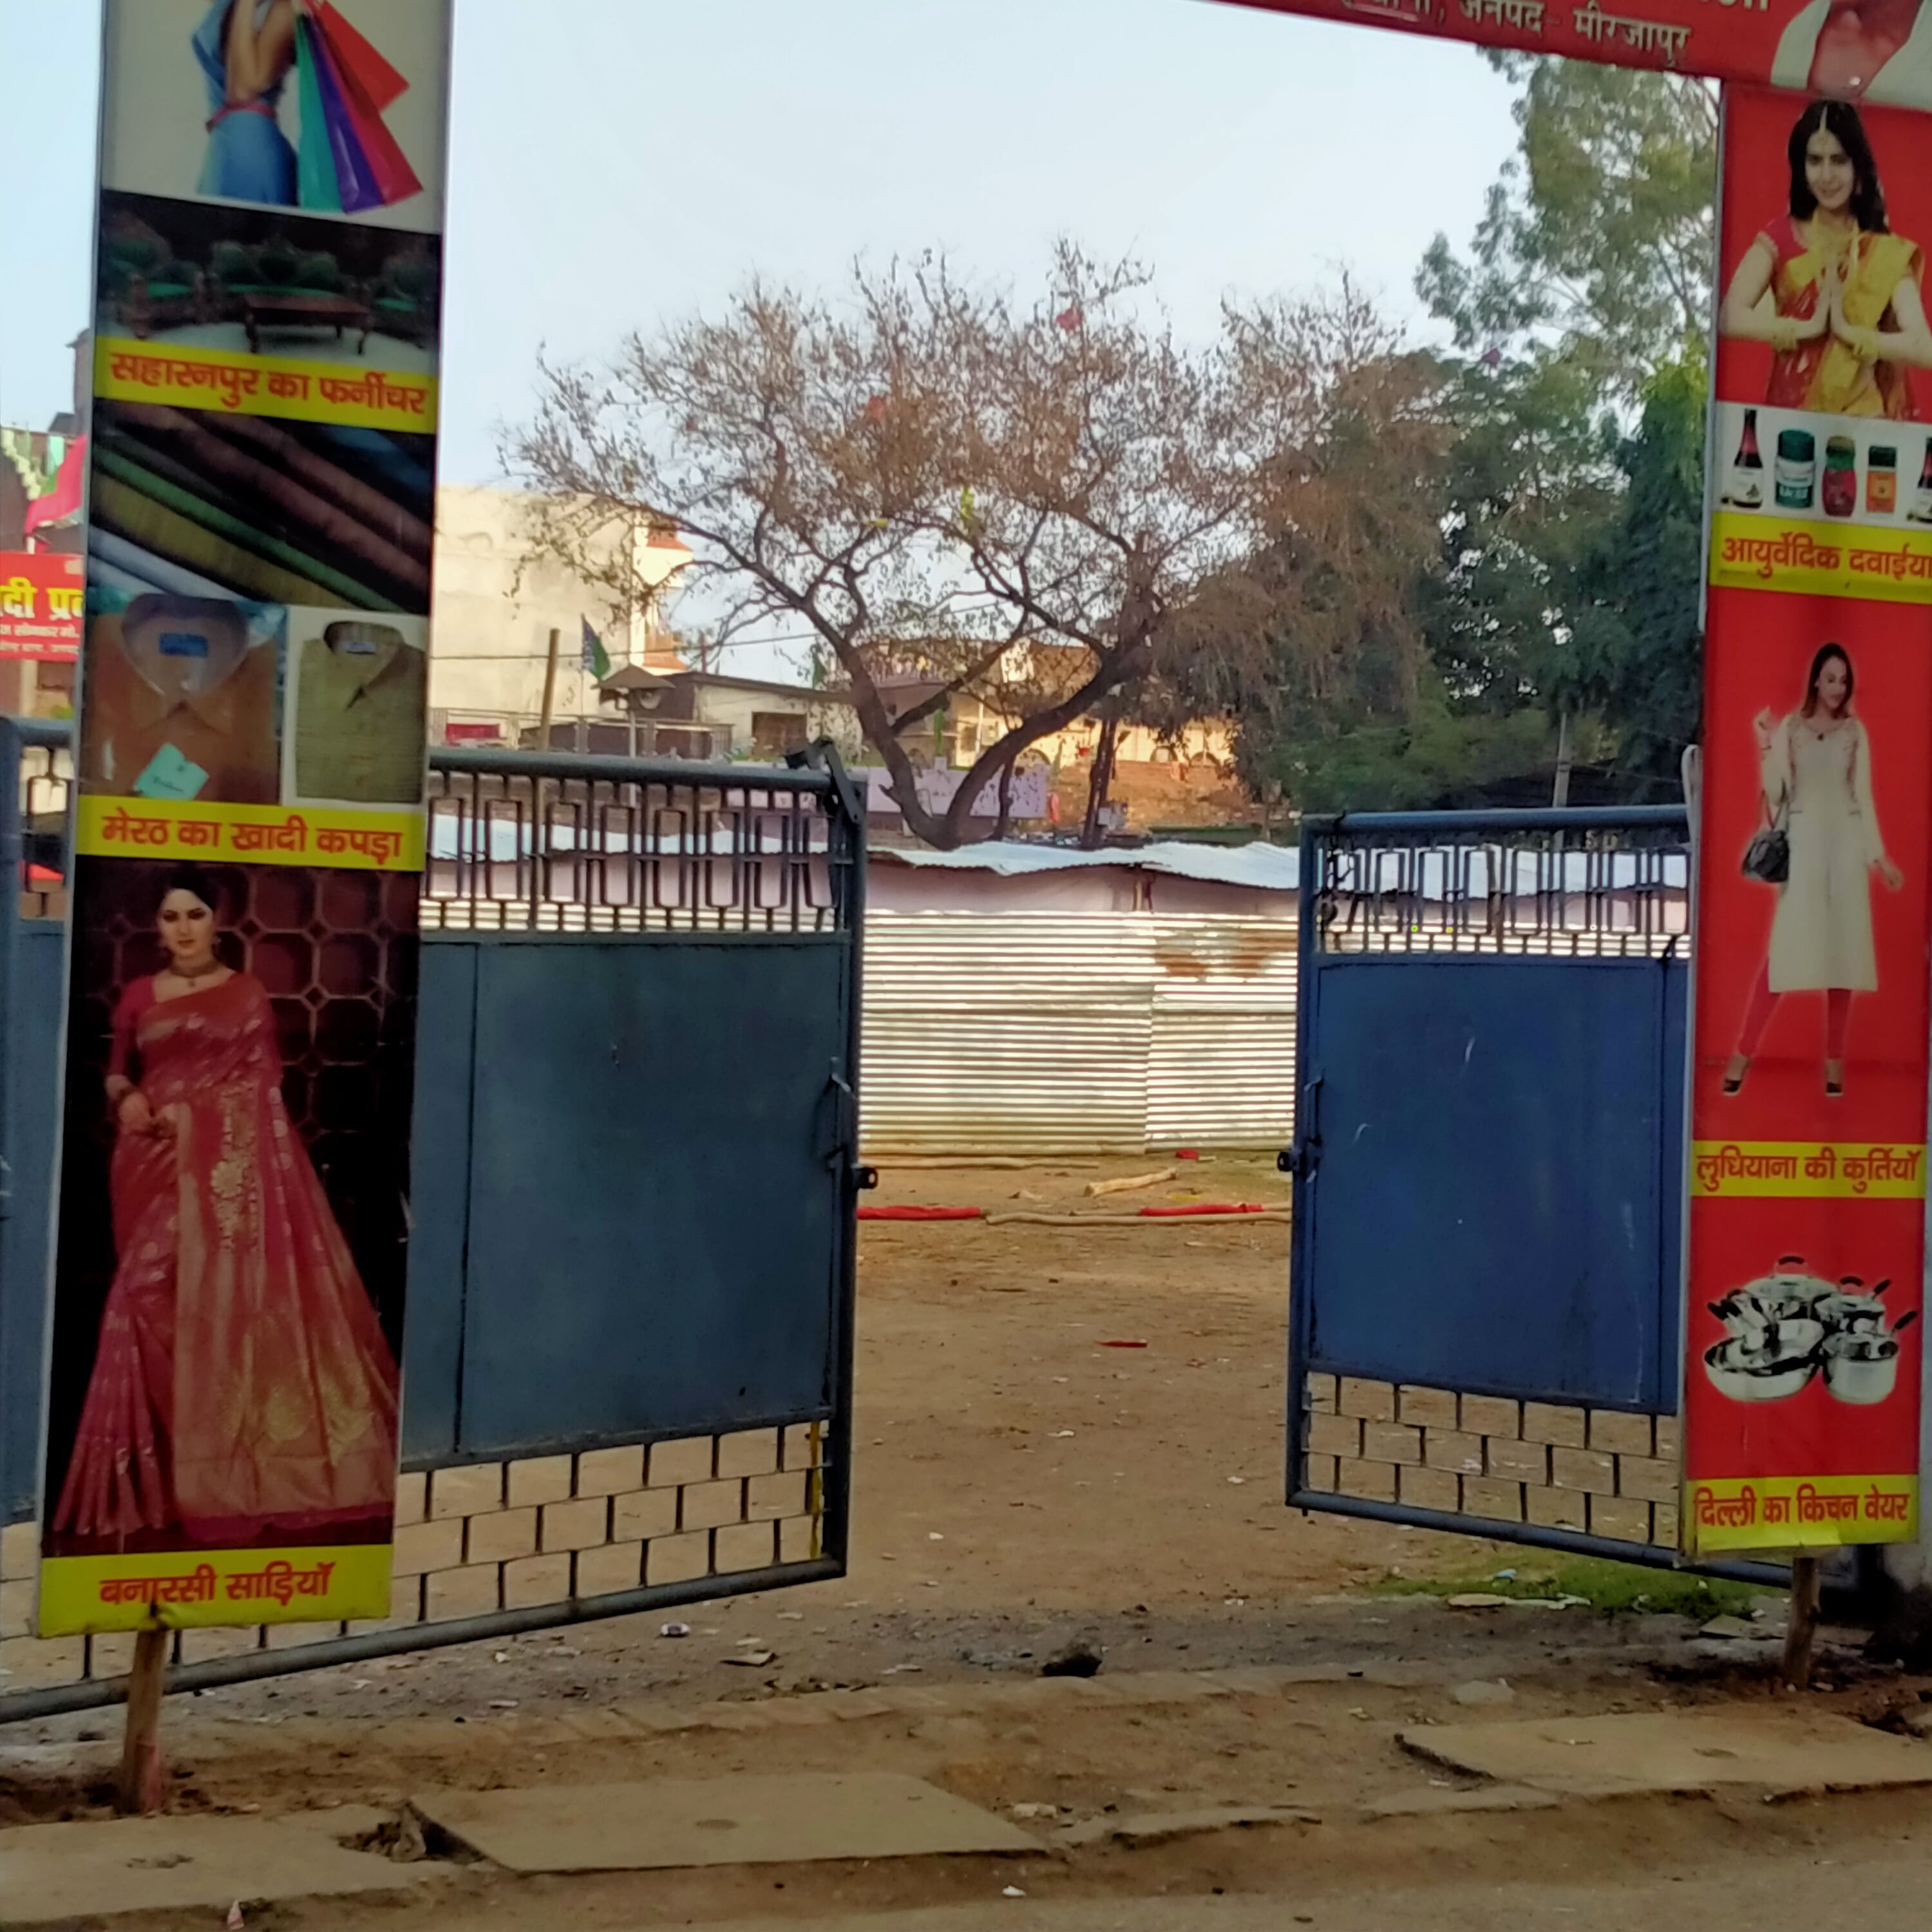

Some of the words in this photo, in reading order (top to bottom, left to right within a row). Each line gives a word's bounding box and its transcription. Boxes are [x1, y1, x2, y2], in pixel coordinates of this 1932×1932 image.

[268, 372, 309, 400] का
[319, 372, 429, 414] फर्नीचर
[101, 806, 171, 845] मेरठ
[177, 820, 222, 847] का
[231, 815, 308, 852] खादी
[316, 828, 403, 865] कपड़ा
[1696, 1145, 1799, 1191] लुधियाना
[1804, 1146, 1837, 1180] की
[1694, 1486, 1757, 1527] दिल्ली
[1762, 1497, 1792, 1524] का
[1797, 1483, 1859, 1522] किचन
[1864, 1484, 1910, 1521] वेयर
[99, 1563, 218, 1604] बनारसी
